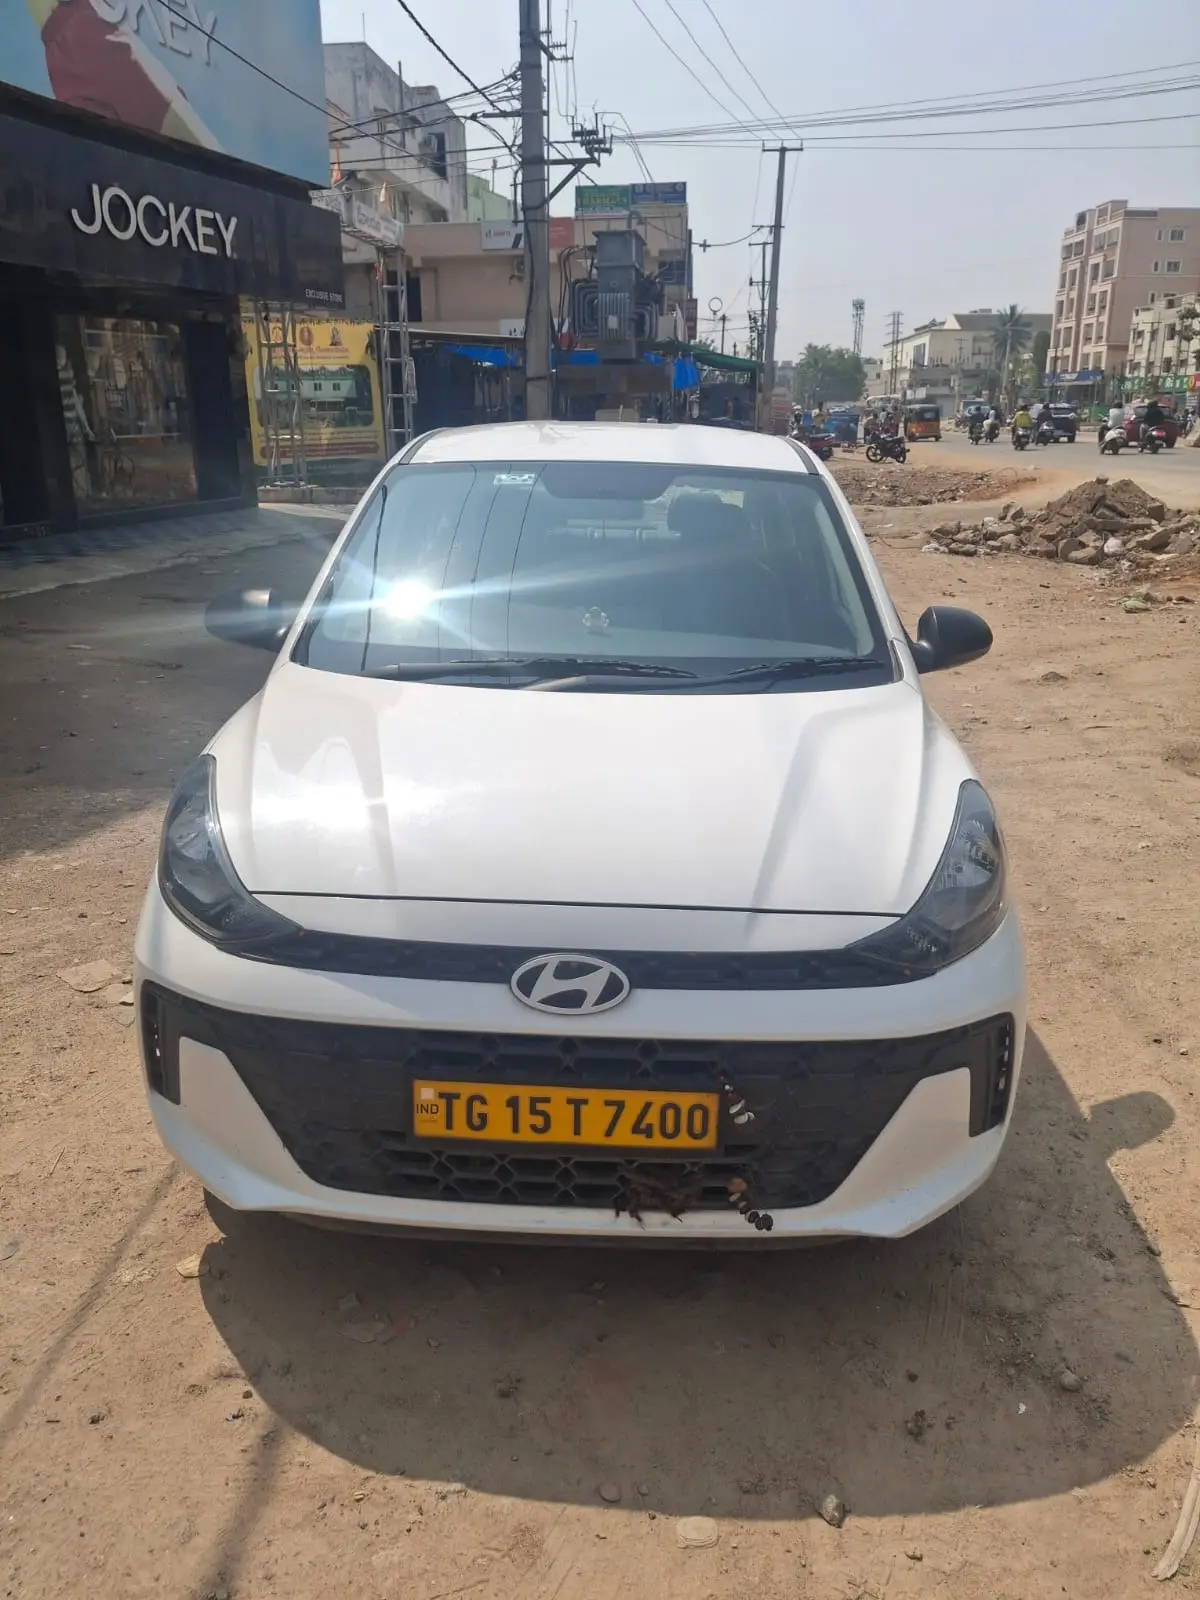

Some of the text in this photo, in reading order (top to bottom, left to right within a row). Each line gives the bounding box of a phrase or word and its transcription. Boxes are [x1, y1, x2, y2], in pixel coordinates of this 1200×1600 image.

[71, 183, 238, 258] JOCKEY
[416, 1103, 439, 1115] IND
[438, 1092, 709, 1140] TG 15 T 7400
